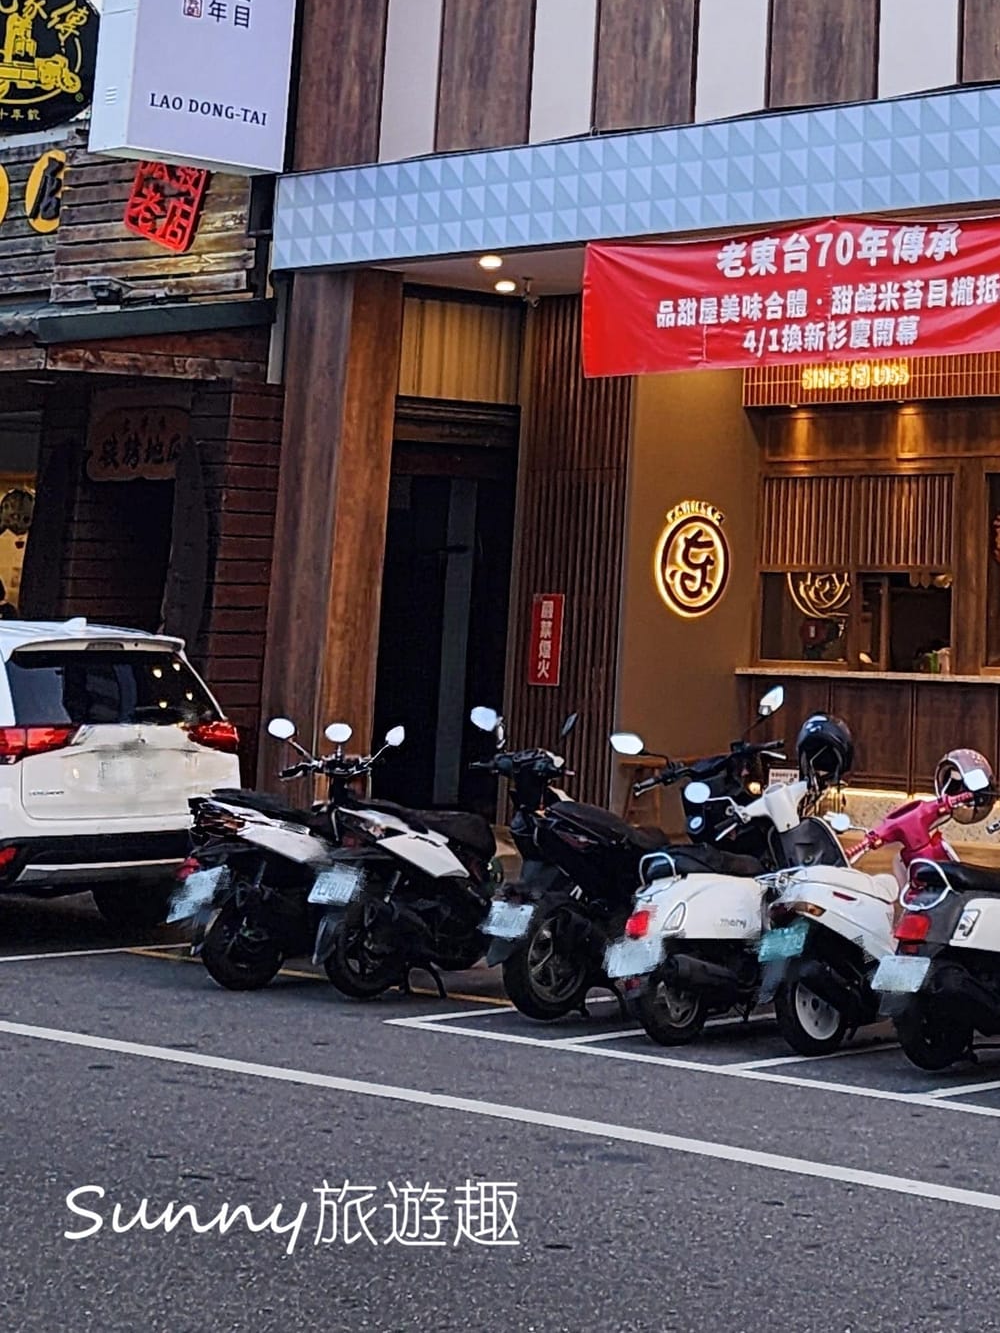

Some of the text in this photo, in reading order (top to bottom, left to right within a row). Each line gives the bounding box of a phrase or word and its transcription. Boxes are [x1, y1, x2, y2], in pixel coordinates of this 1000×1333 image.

[150, 93, 268, 126] LAO DONG-TAI
[716, 223, 962, 279] 老東台70年傳承
[743, 315, 921, 358] 4/1換新衫慶開幕
